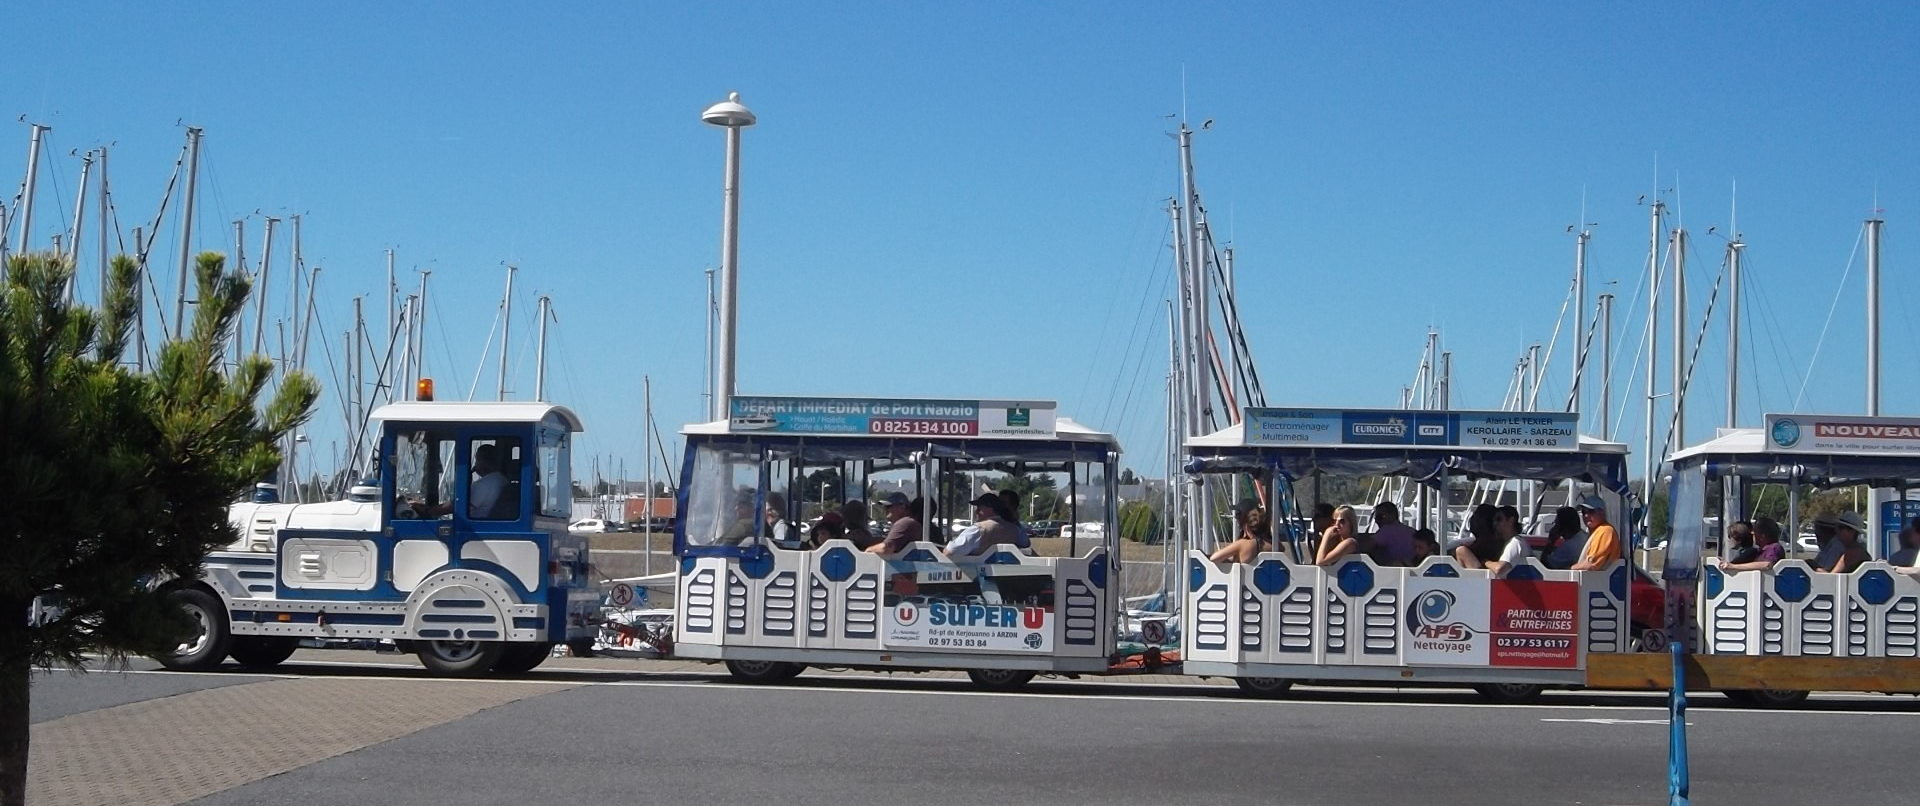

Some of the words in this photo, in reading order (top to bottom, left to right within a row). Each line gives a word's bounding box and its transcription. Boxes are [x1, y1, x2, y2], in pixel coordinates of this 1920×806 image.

[740, 398, 795, 413] DÉPART
[798, 398, 869, 415] IMMÉDIAT
[872, 402, 889, 415] de
[892, 403, 922, 416] Port
[1262, 411, 1289, 419] Image
[1485, 417, 1507, 425] Alain
[1509, 417, 1520, 425] LE
[1522, 417, 1553, 426] TEXIER
[814, 424, 822, 432] du
[824, 424, 857, 433] Morbihan
[872, 421, 881, 433] 0
[884, 421, 911, 433] 825
[913, 421, 939, 434] 134
[941, 422, 969, 434] 100
[1355, 425, 1400, 434] EURONICS
[1467, 426, 1522, 435] KEROLLAIRE
[1530, 428, 1572, 436] SARZEAU
[1482, 437, 1496, 445] Tél.
[1499, 438, 1509, 446] 02
[1511, 438, 1521, 446] 97
[1523, 438, 1532, 446] 41
[928, 571, 952, 581] SUPER
[956, 570, 962, 580] U
[900, 608, 913, 621] U
[928, 602, 1018, 628] SUPER
[1023, 606, 1045, 630] U
[1506, 608, 1573, 621] PARTICULIERS
[1509, 619, 1572, 630] ENTREPRISES
[928, 629, 946, 638] Rd-pt
[947, 629, 955, 637] de
[956, 630, 990, 639] Kerjouanno
[1416, 624, 1464, 639] APS
[928, 637, 939, 646] 02
[940, 638, 951, 646] 97
[952, 638, 963, 647] 53
[965, 639, 975, 647] 83
[976, 639, 987, 647] 84
[1413, 640, 1472, 653] Nettoyage
[1497, 638, 1512, 648] 02
[1513, 638, 1527, 648] 97
[1528, 638, 1542, 648] 53
[1544, 639, 1557, 649] 61
[1558, 639, 1570, 649] 17
[1497, 651, 1569, 659] aps.nettoyage@hotmail.fr
